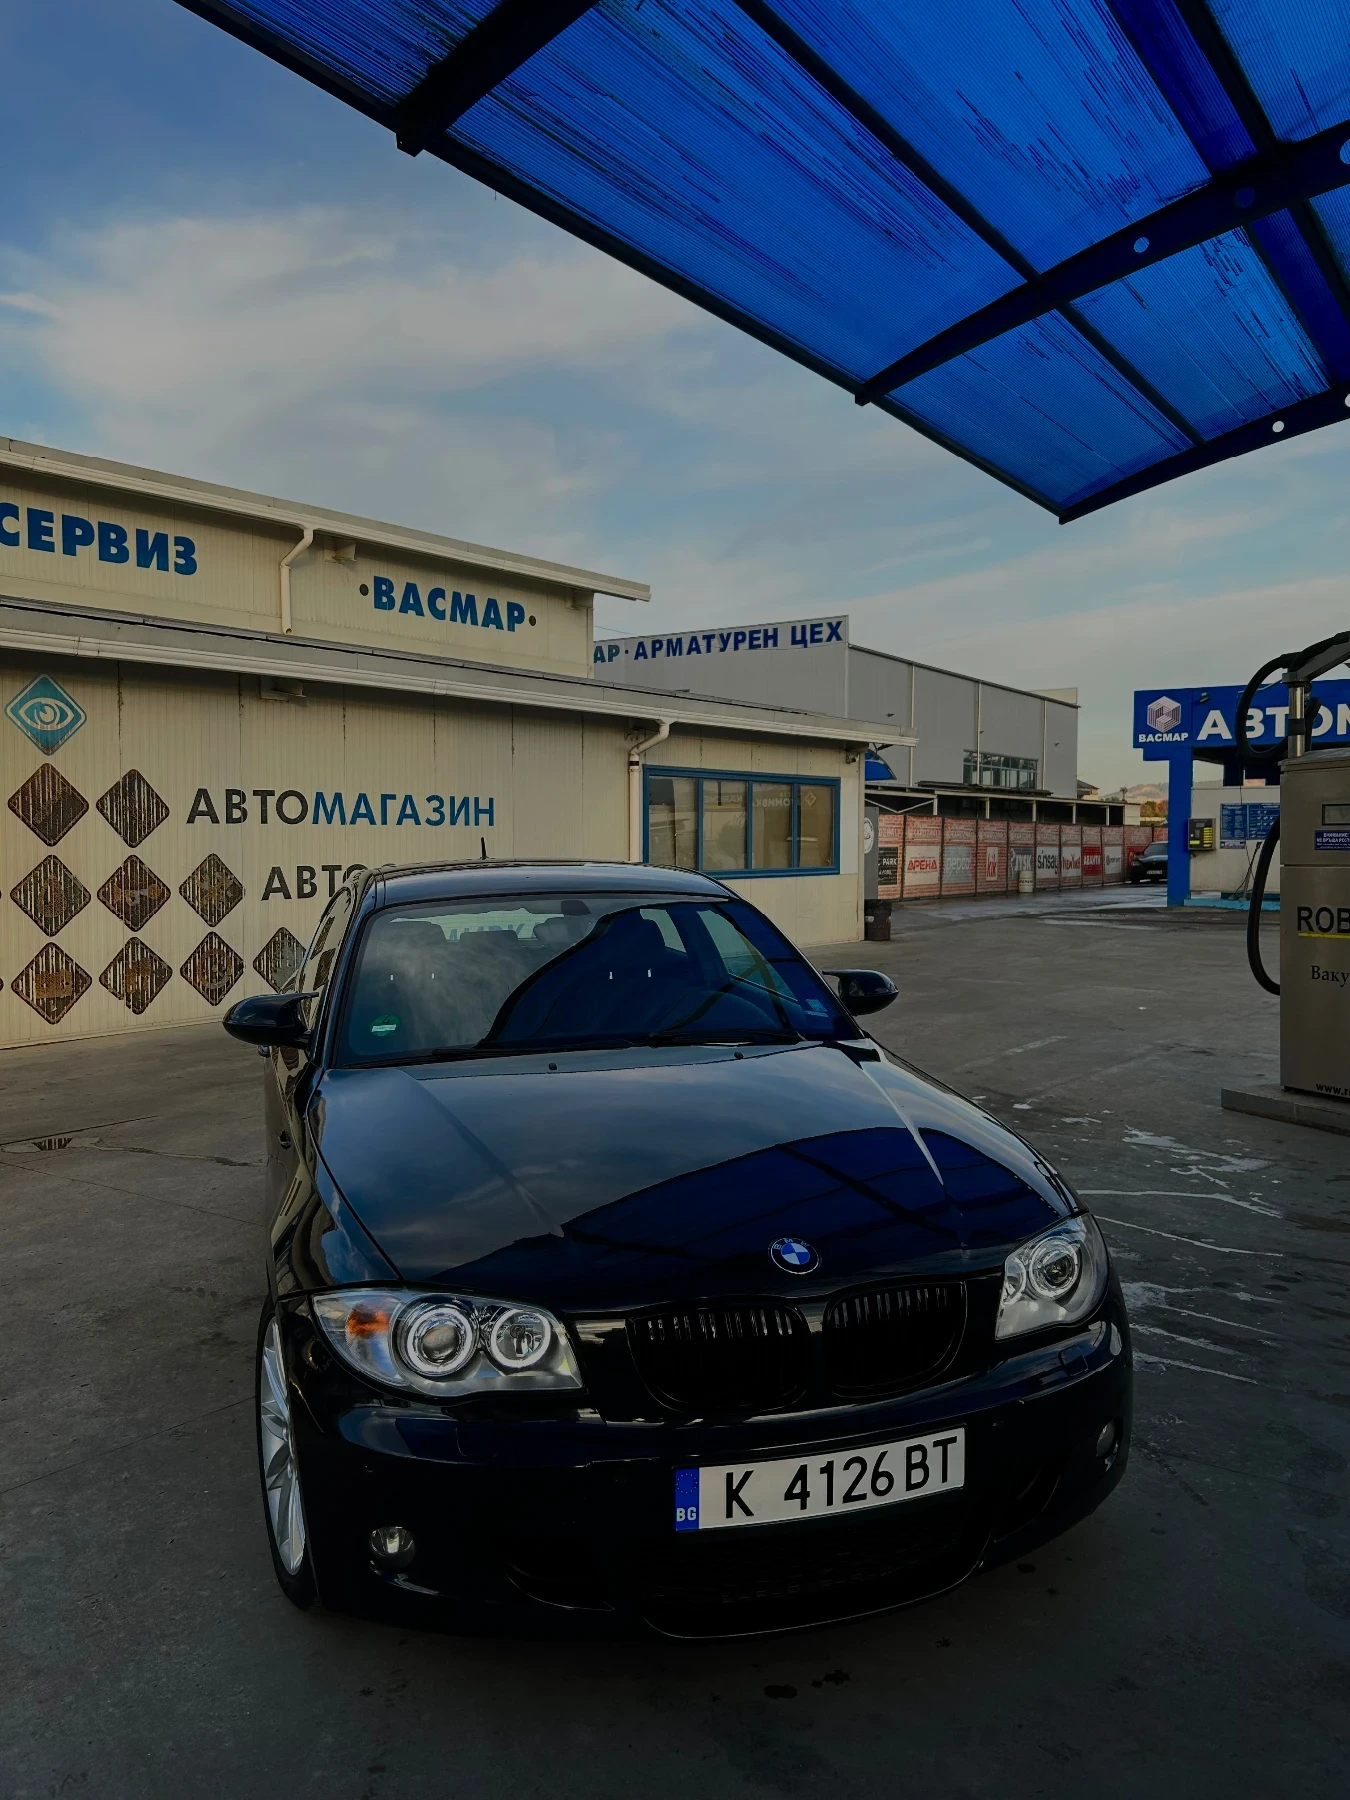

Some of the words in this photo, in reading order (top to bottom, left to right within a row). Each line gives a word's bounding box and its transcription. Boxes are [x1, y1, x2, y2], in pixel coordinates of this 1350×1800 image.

[0, 502, 198, 576] СЕРВИЗ
[373, 575, 526, 632] ВАСМАР
[633, 627, 779, 661] АРМАТУРЕН
[790, 620, 844, 648] ЦЕХ
[1138, 732, 1189, 743] ВАСМАР
[186, 788, 495, 827] АВТОМАГАЗИН
[1037, 850, 1058, 875] sinsay
[1297, 906, 1350, 933] ROB
[725, 1469, 755, 1519] K
[676, 1507, 697, 1522] BG
